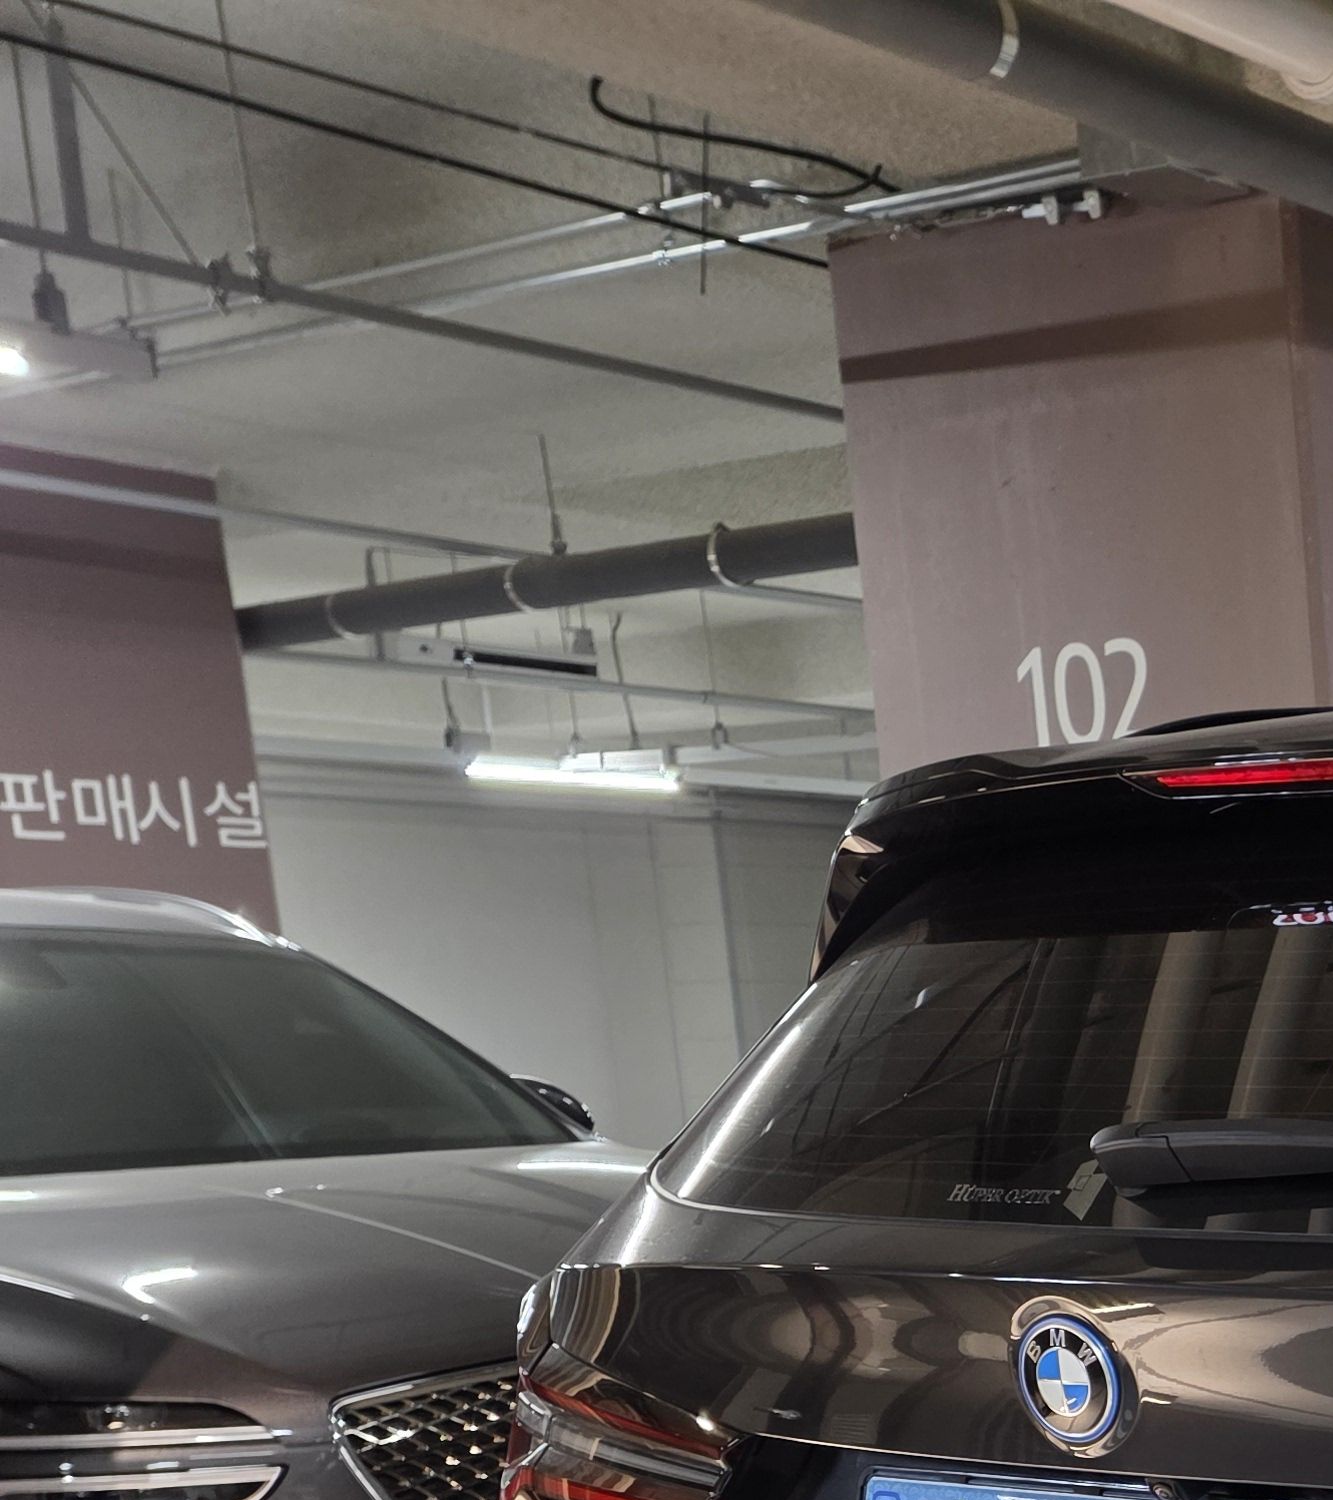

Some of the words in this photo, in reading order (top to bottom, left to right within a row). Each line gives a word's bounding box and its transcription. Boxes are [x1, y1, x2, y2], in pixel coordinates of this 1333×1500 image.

[1016, 637, 1148, 748] 102
[0, 769, 268, 849] 판매시설
[1027, 1328, 1098, 1367] BMW
